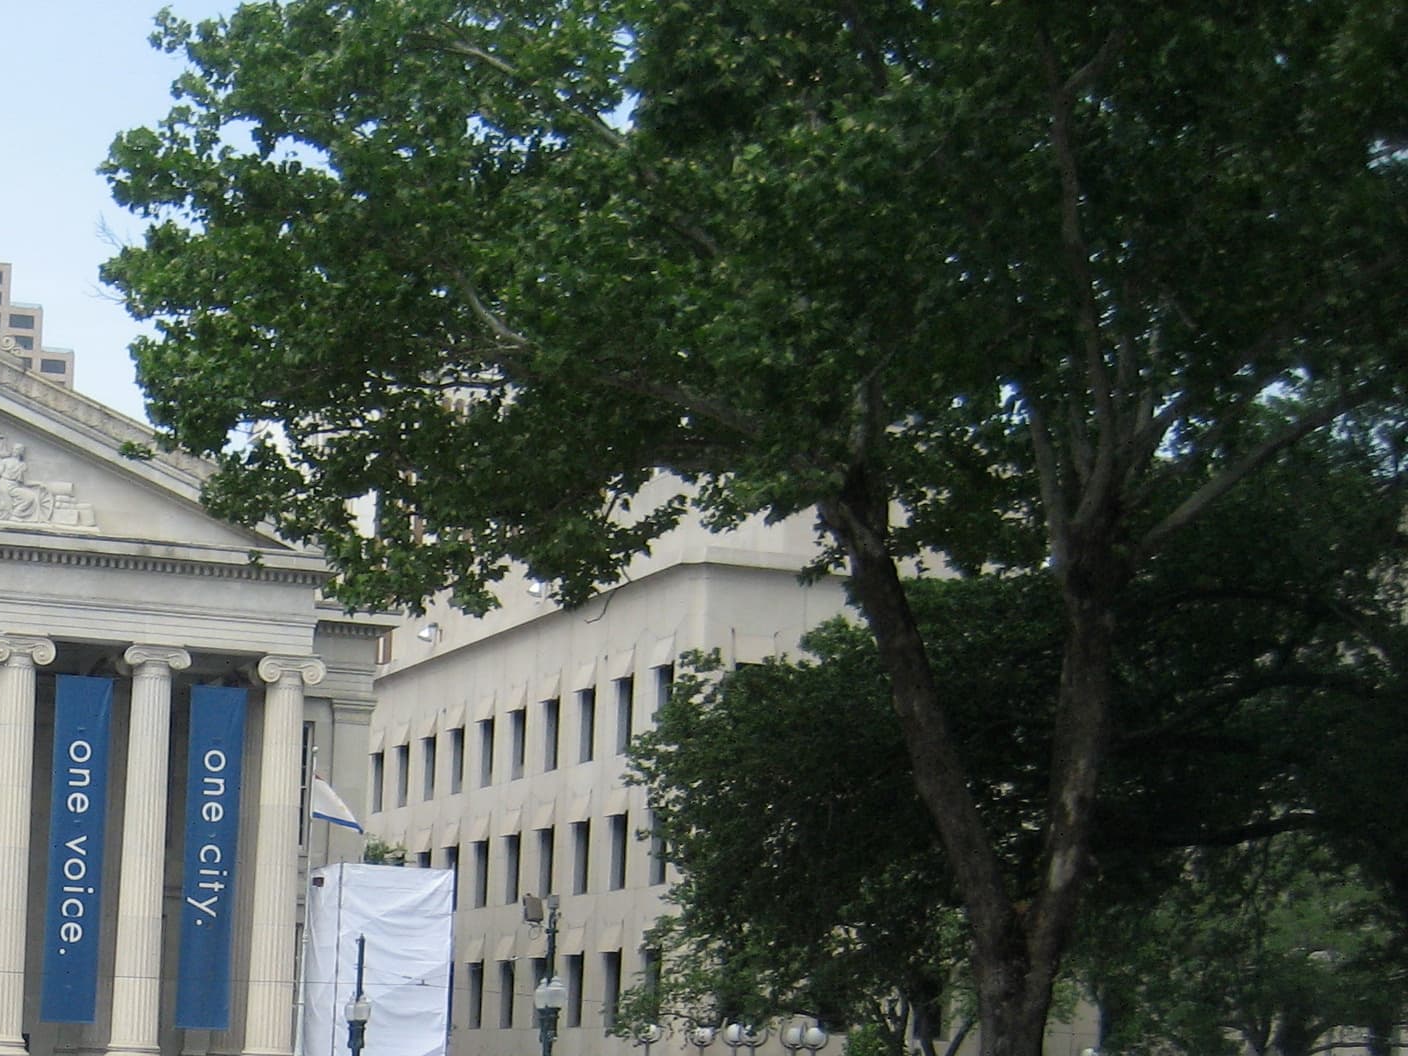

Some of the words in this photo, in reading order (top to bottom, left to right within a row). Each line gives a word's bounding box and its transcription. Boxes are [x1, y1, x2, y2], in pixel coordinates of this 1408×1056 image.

[67, 740, 92, 813] one
[201, 749, 226, 822] one
[59, 835, 94, 955] voice.
[187, 845, 228, 926] city.
